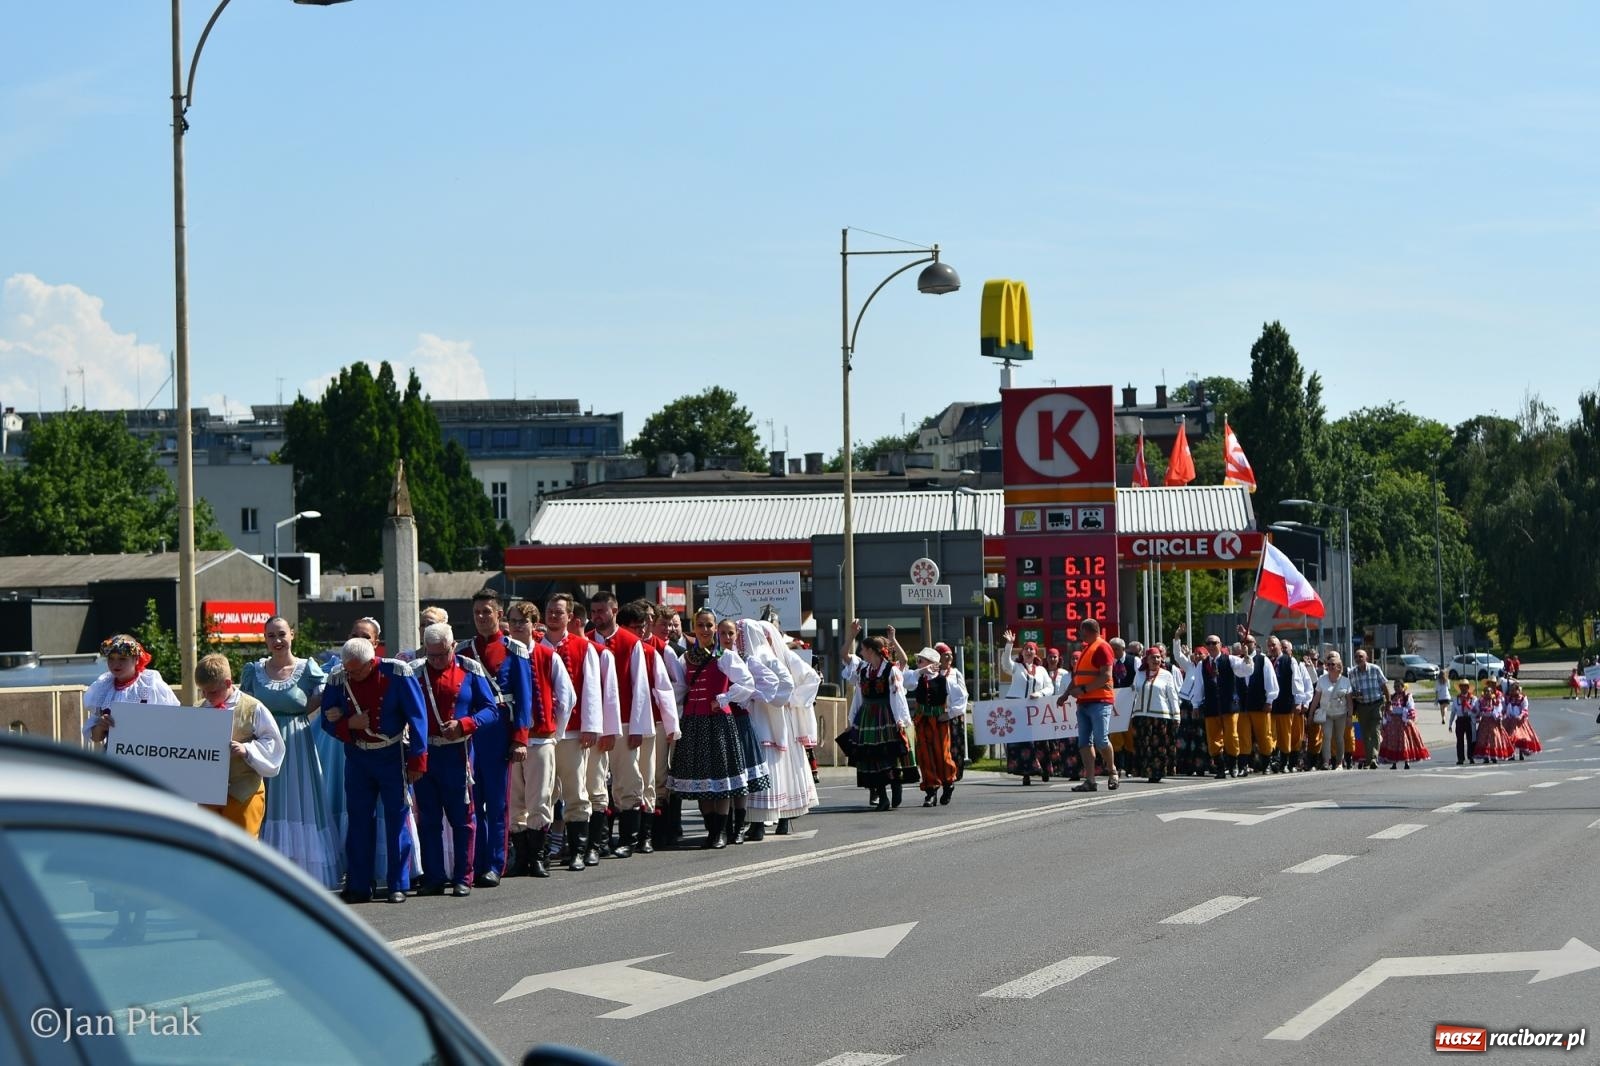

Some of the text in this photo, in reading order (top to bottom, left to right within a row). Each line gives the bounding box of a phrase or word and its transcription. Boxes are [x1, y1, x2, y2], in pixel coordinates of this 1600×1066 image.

[1037, 410, 1091, 473] K
[1132, 538, 1208, 556] CIRCLE
[1024, 556, 1105, 575] D 6.12
[908, 588, 944, 598] PATRIA
[1023, 579, 1106, 598] 95 5.94
[1025, 602, 1106, 620] D 6.12
[1024, 631, 1038, 640] 95
[115, 743, 221, 762] RACIBORZANIE
